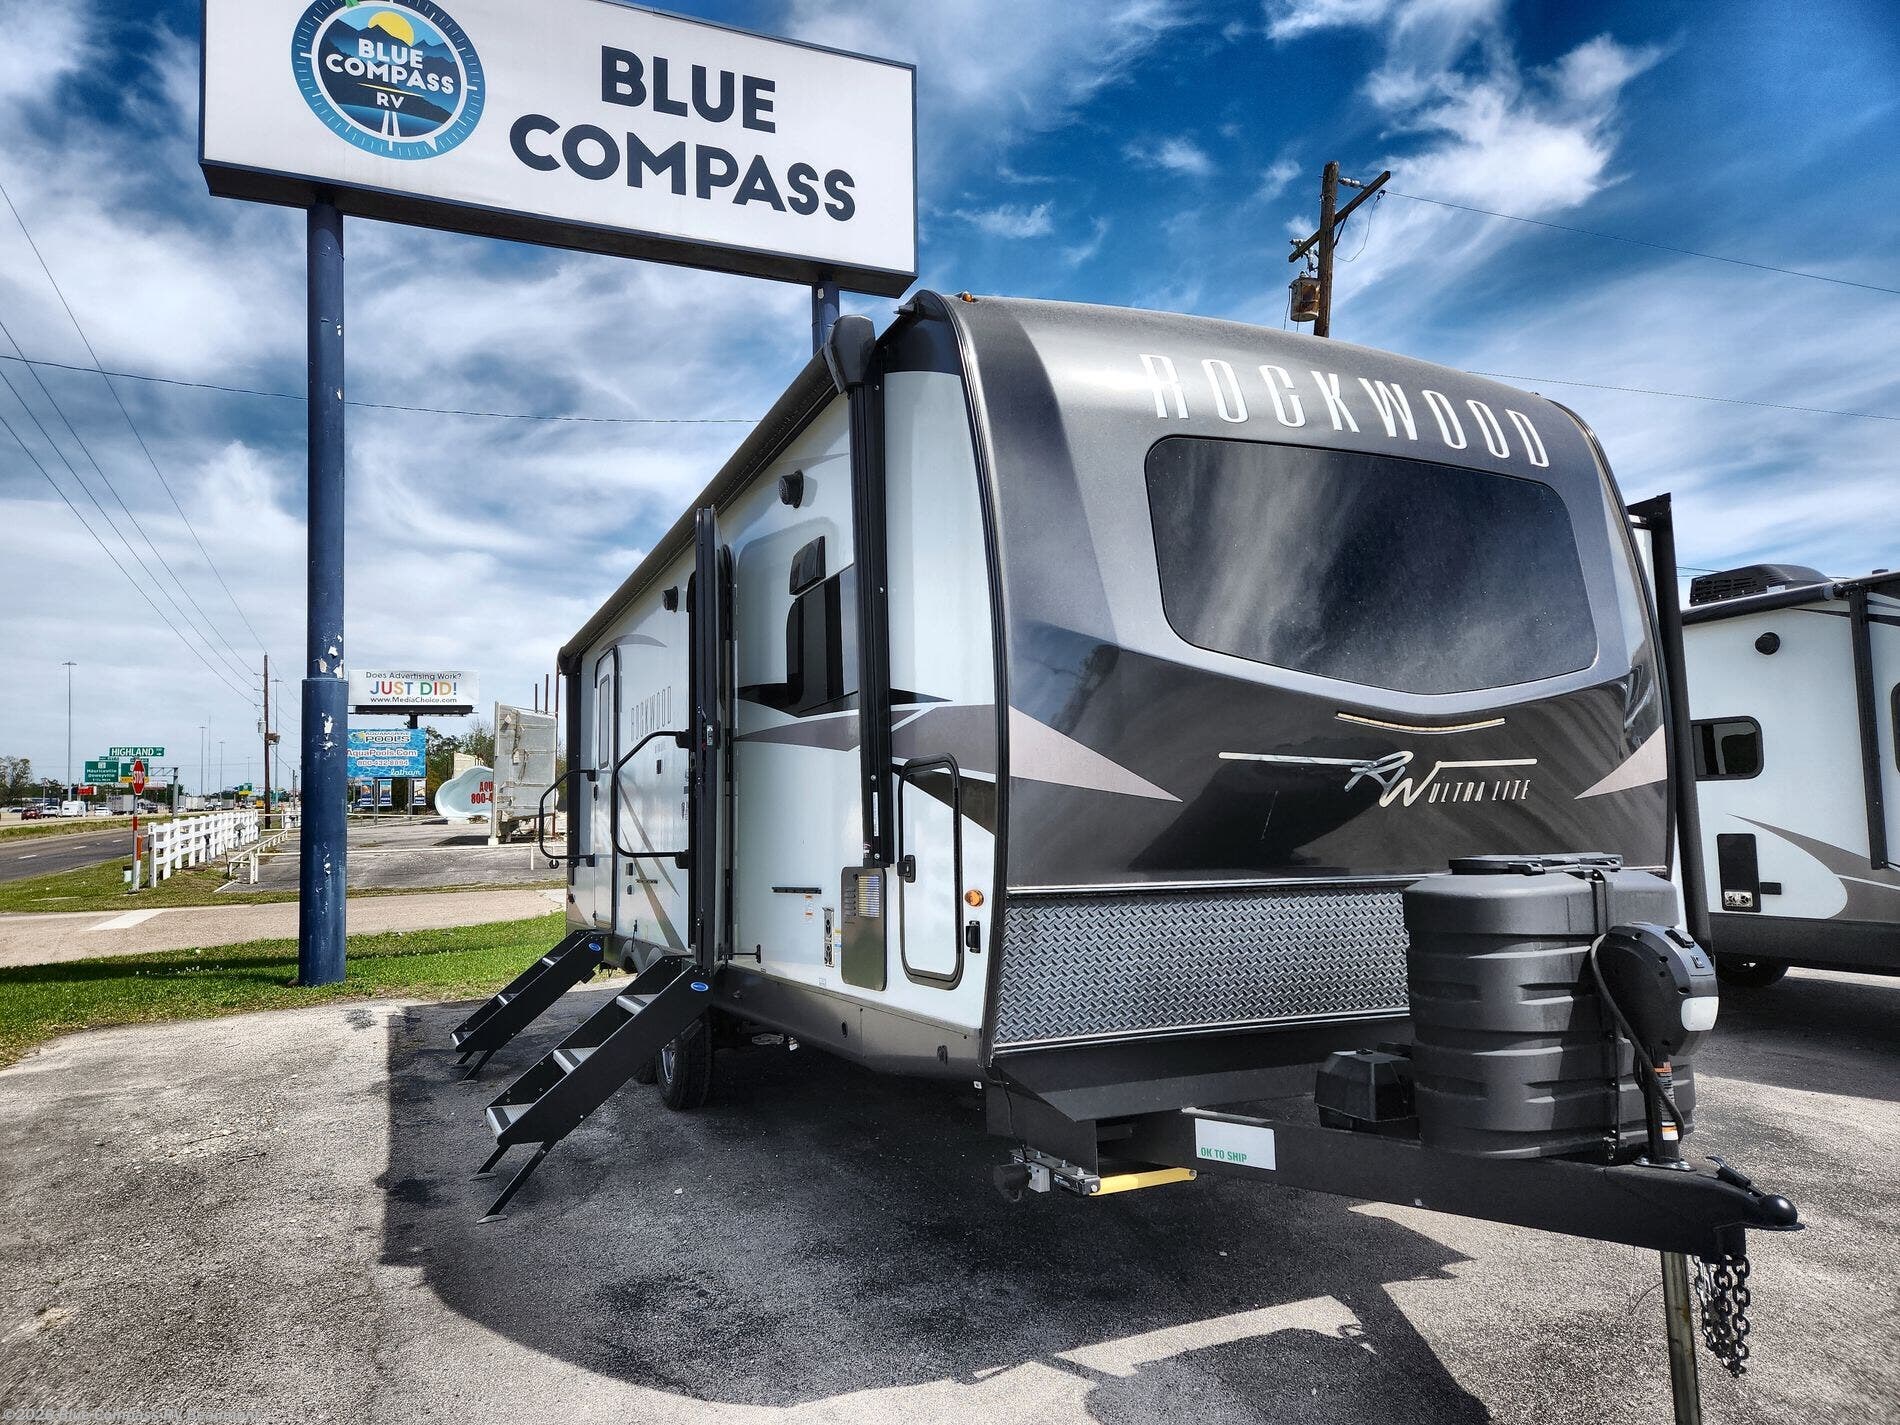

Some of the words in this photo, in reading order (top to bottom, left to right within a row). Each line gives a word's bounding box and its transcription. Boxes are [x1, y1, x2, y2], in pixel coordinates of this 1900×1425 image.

[358, 38, 424, 70] BLUE
[325, 53, 454, 95] COMPASS
[601, 45, 776, 134] BLUE
[376, 92, 405, 109] RV
[509, 114, 856, 222] COMPASS
[1139, 353, 1550, 467] ROCKWOOD
[366, 671, 387, 679] Does
[389, 672, 435, 681] Advertising
[370, 681, 414, 695] JUST
[420, 682, 457, 696] DID!
[111, 747, 154, 756] HIGHLAND
[347, 749, 417, 757] AquaPools.Com
[134, 771, 145, 784] STOP
[1428, 782, 1485, 803] ULTRA
[1491, 779, 1531, 801] LITE
[1201, 1147, 1212, 1158] OK
[1215, 1149, 1225, 1159] TO
[1227, 1151, 1247, 1162] SHIP
